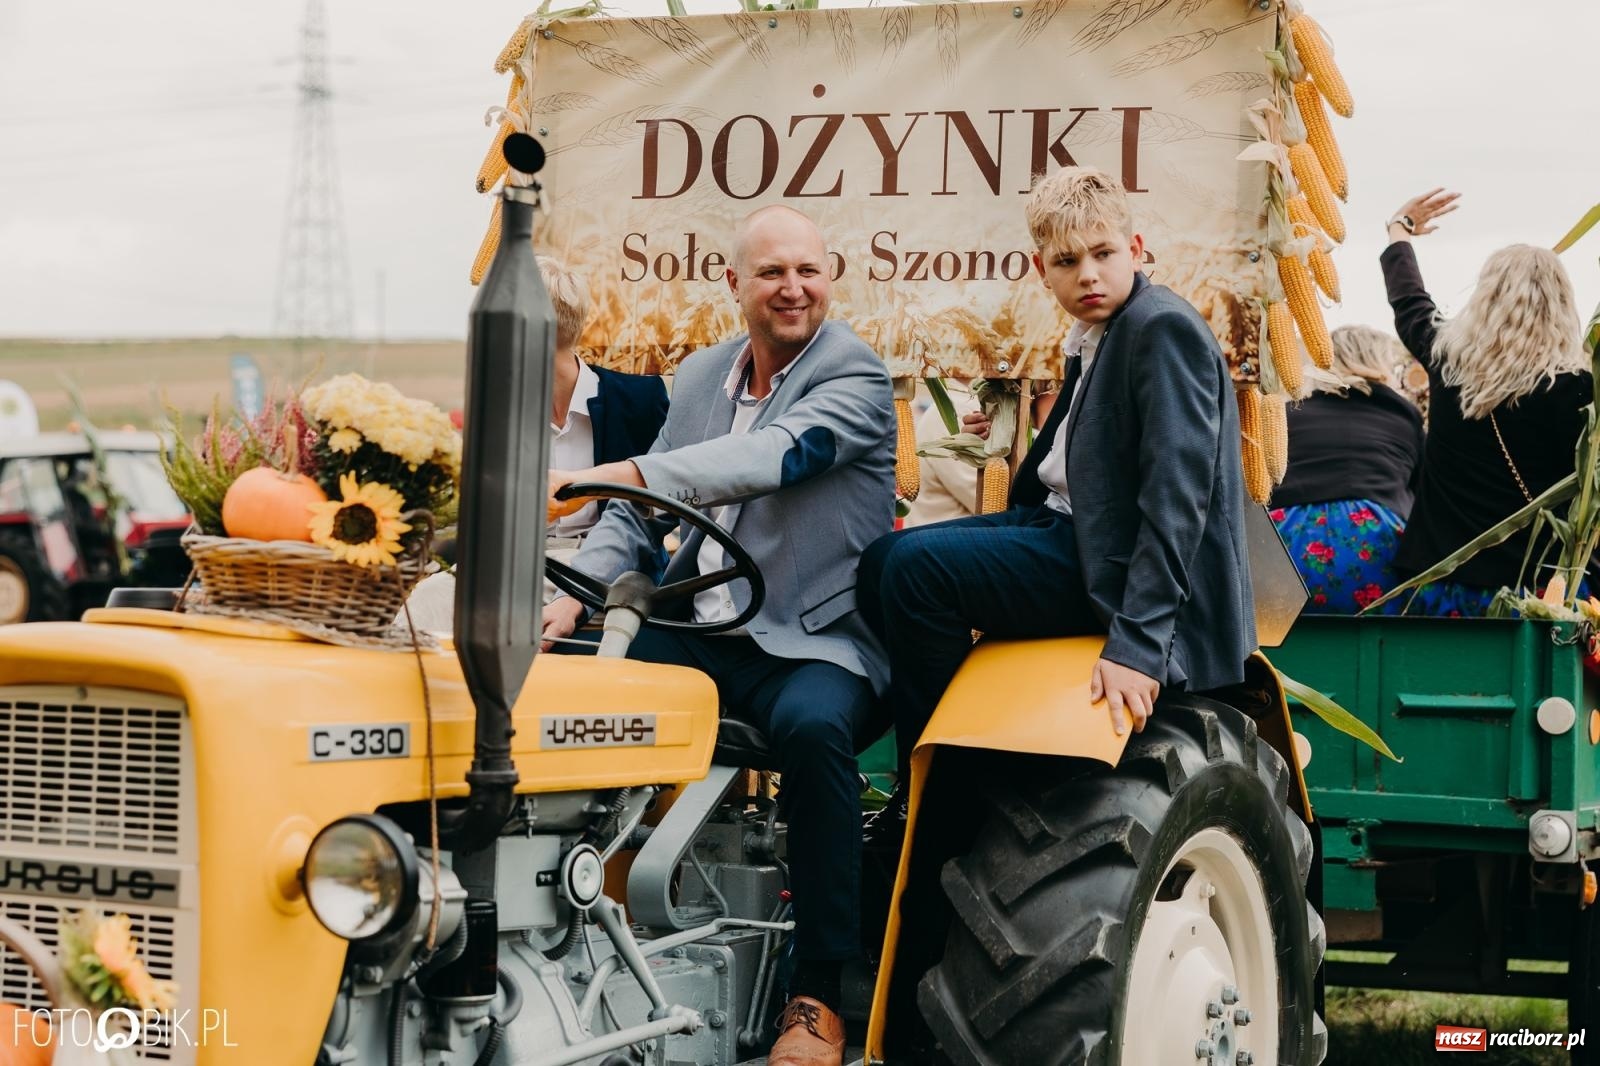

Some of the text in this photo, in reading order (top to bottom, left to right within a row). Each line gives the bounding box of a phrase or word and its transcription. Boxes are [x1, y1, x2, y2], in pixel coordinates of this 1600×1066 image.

[631, 83, 1153, 200] DOŻYNKI
[620, 230, 1156, 283] Sołeo Szono
[312, 727, 405, 758] C-330
[551, 717, 646, 745] URSUS
